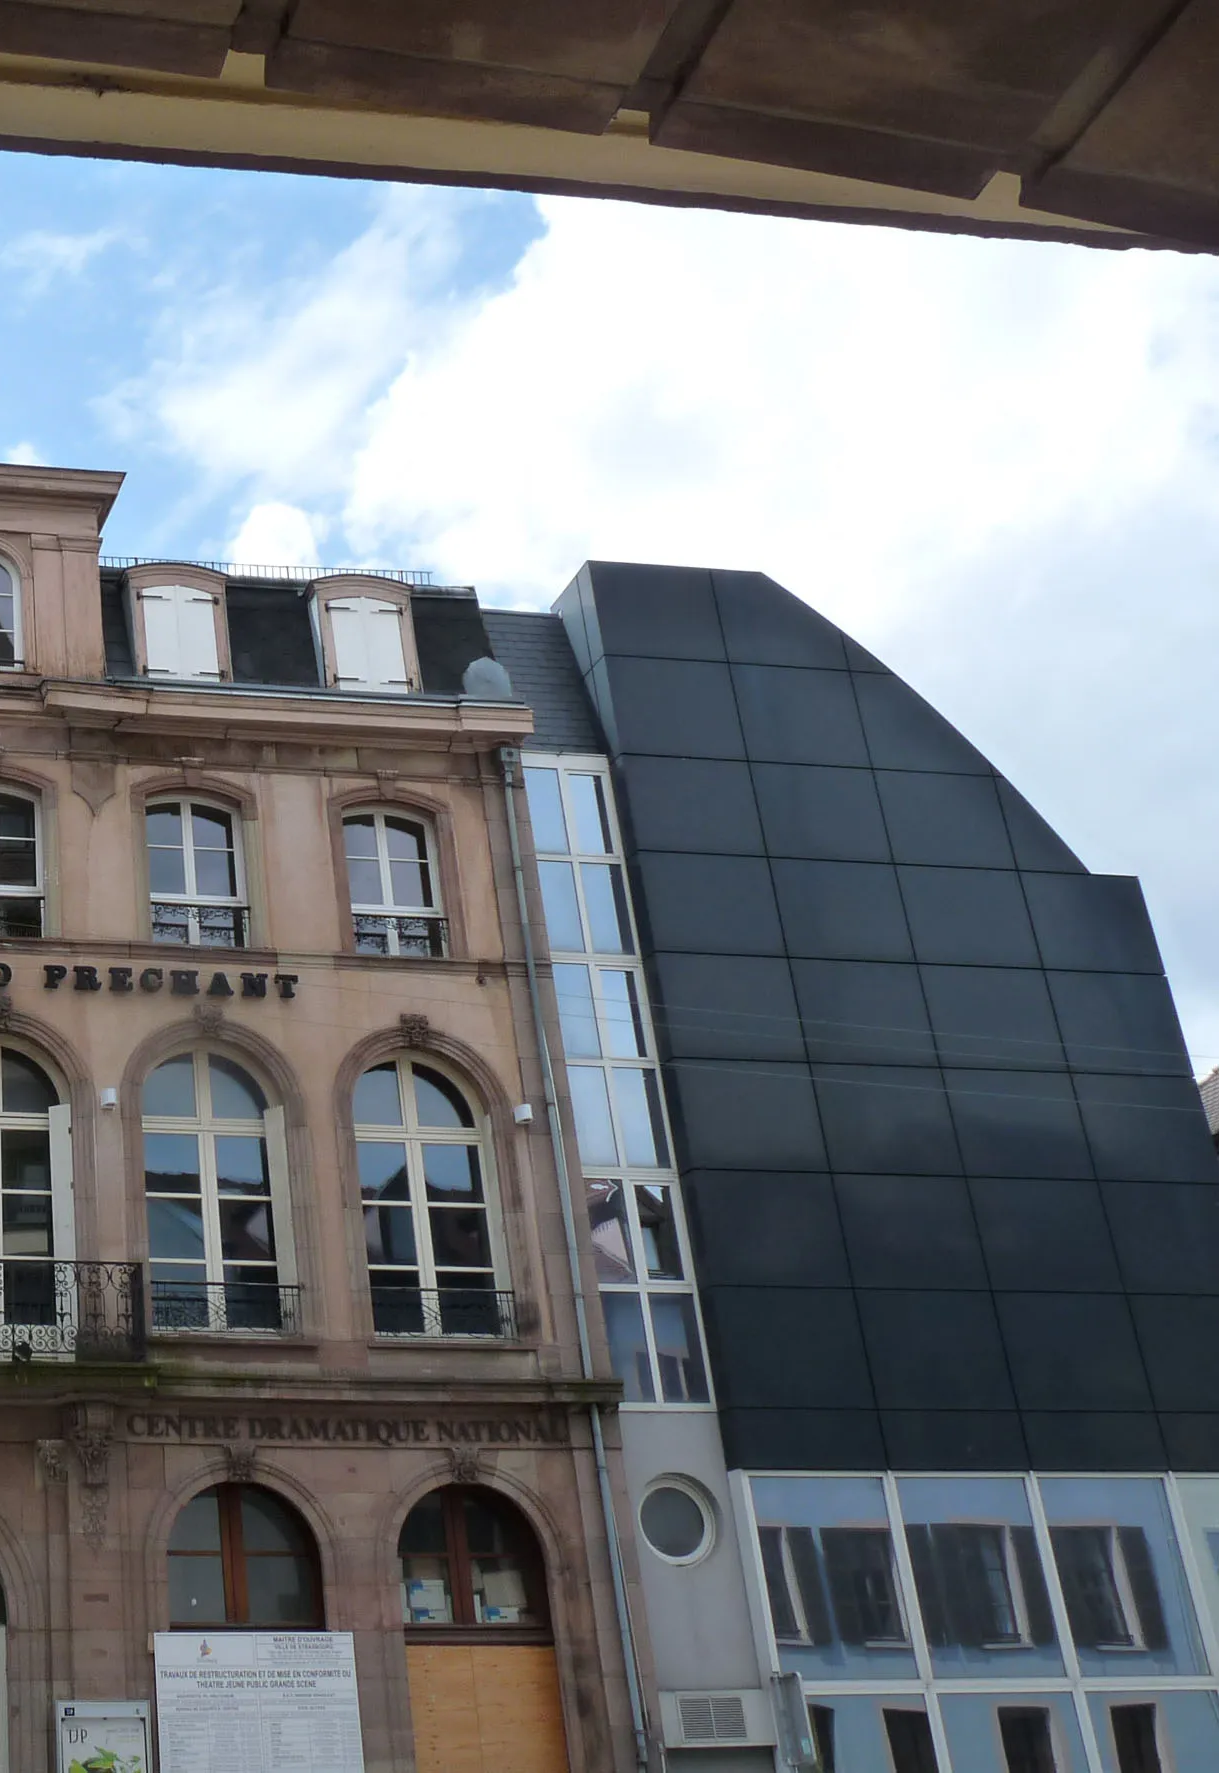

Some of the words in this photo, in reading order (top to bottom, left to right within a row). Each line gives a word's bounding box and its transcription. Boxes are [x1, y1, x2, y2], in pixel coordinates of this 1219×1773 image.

[43, 964, 299, 999] PRECHANT
[126, 1413, 240, 1439] CENTRE
[248, 1414, 430, 1445] DRAMATIQUE
[436, 1419, 570, 1443] NATIONAL
[160, 1670, 188, 1679] TRAVAUX
[189, 1670, 197, 1679] DE
[199, 1670, 257, 1679] RESTRUCTURATION
[258, 1670, 266, 1678] ET
[267, 1670, 276, 1678] DE
[277, 1670, 292, 1678] MISE
[293, 1670, 301, 1678] EN
[342, 1669, 351, 1677] DU
[226, 1680, 245, 1688] JEUNE
[246, 1680, 268, 1688] PUBLIC
[269, 1680, 295, 1688] GRANDE
